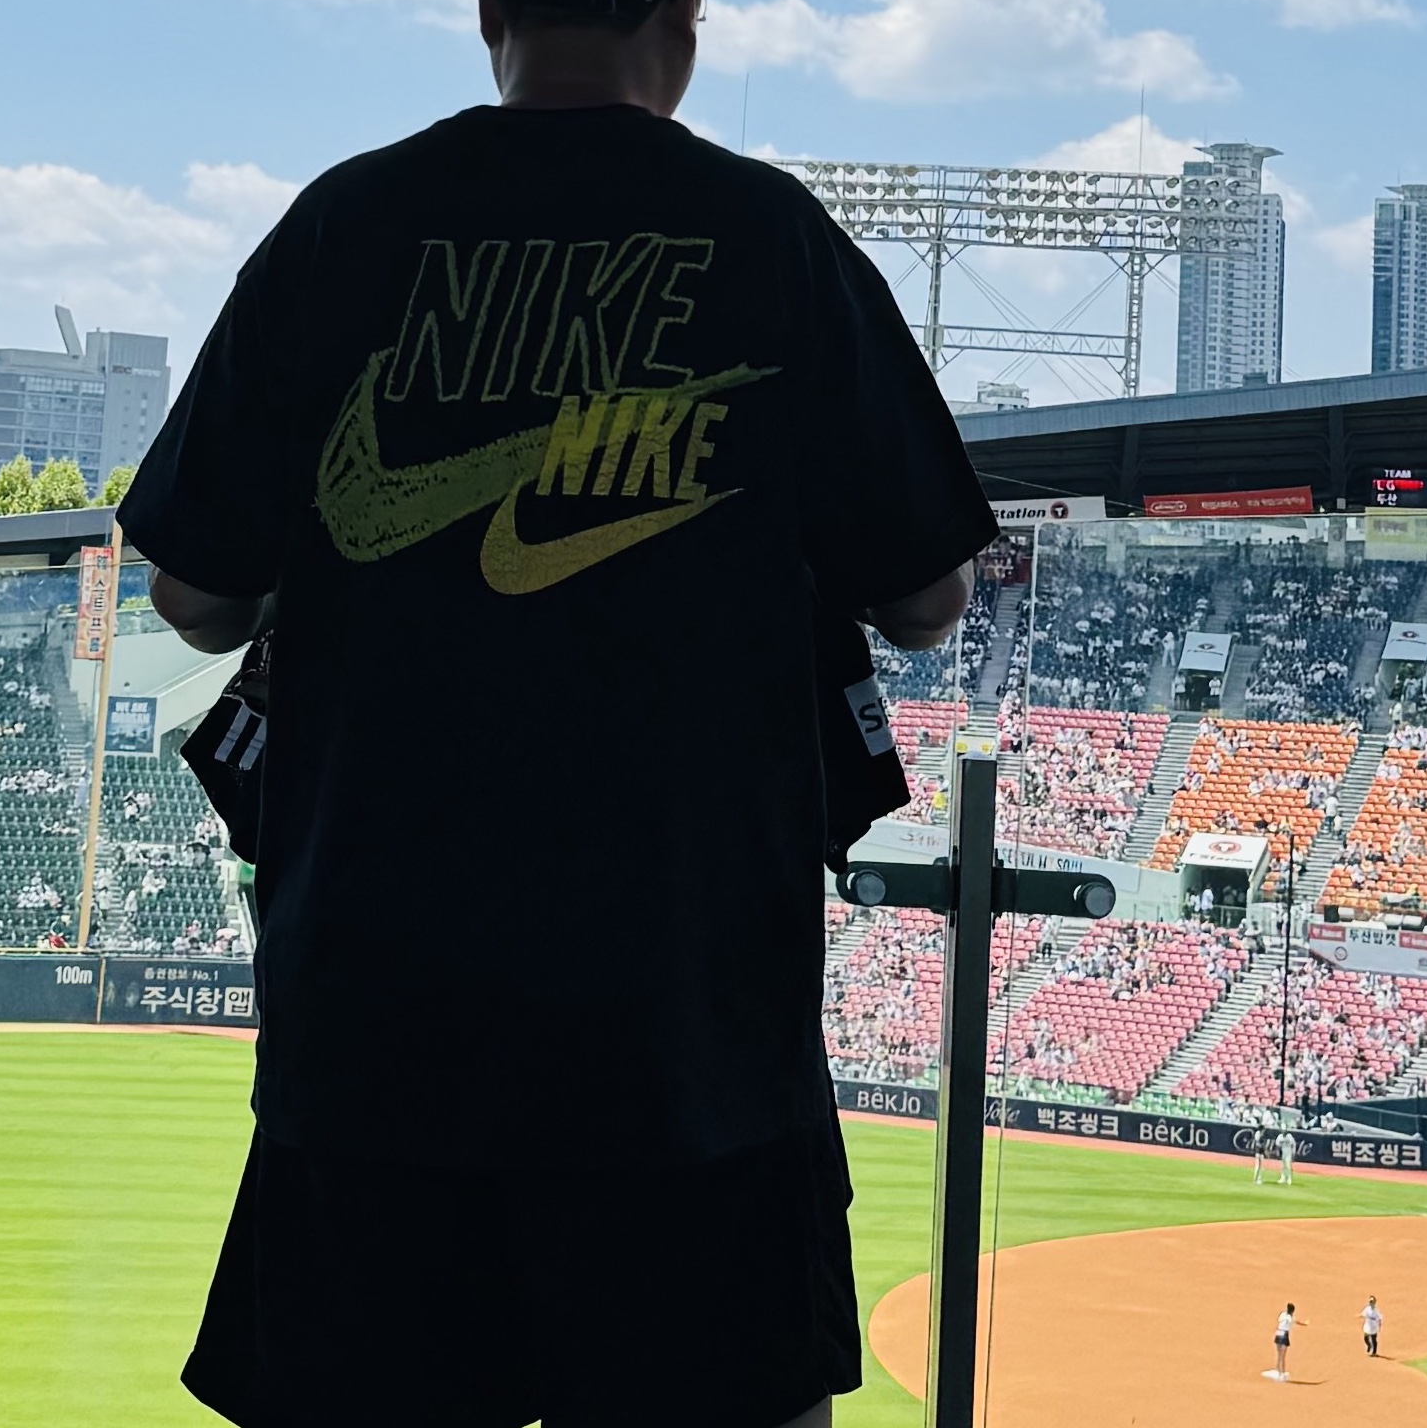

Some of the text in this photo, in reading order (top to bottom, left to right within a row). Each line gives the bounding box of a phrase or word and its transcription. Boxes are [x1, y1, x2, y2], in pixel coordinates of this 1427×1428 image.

[385, 232, 714, 403] NIKE
[536, 394, 729, 503] NIKE
[1384, 469, 1412, 479] TEAM
[1349, 928, 1396, 946] 두산밥캣
[55, 965, 93, 985] 100m
[139, 986, 255, 1018] 주식창앱
[1037, 1107, 1120, 1137] 백조씽크
[1331, 1140, 1422, 1167] 백조씽크
